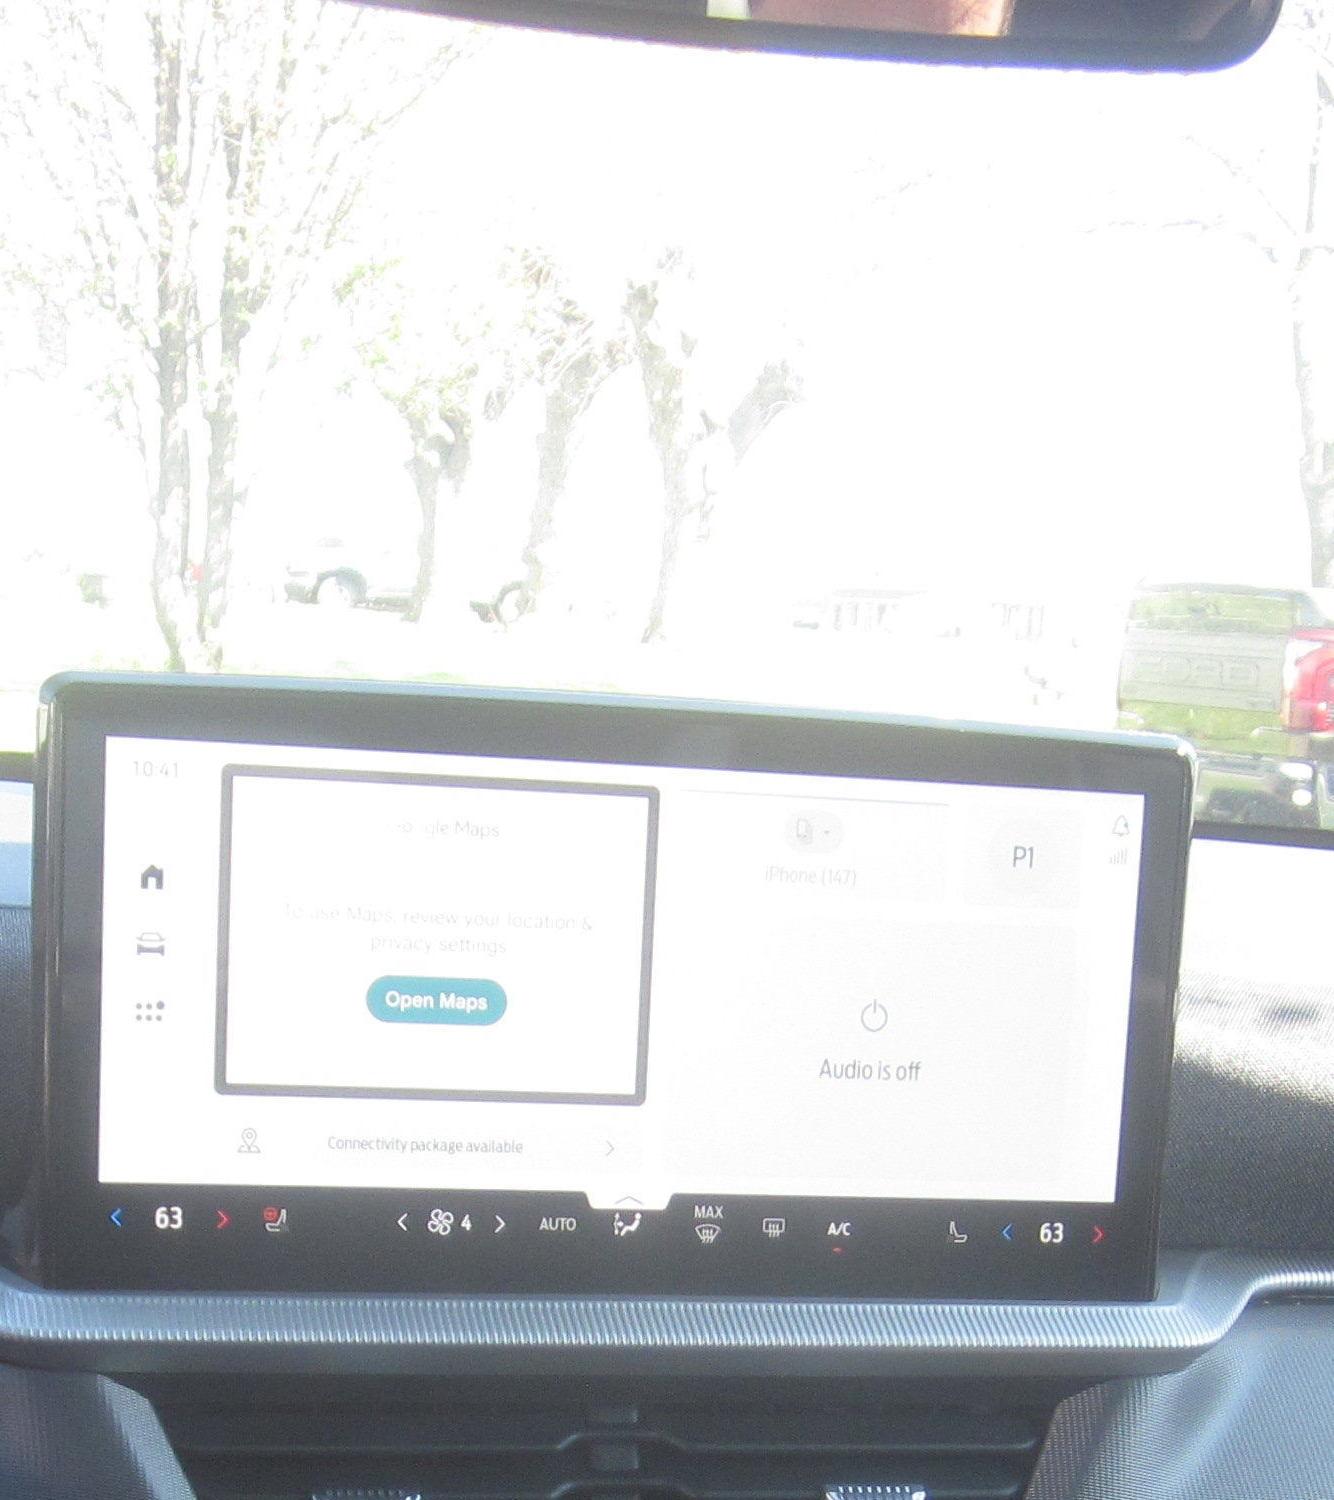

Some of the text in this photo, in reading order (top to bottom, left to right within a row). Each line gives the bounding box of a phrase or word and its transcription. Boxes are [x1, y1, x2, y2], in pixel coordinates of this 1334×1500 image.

[1012, 845, 1035, 869] P1
[765, 866, 817, 885] iPhone
[438, 934, 507, 957] settings
[385, 990, 488, 1013] Open Maps
[819, 1059, 922, 1082] Audio is off
[327, 1136, 524, 1155] Connectivity package available
[154, 1206, 577, 1232] 63 4 AUTO
[694, 1205, 724, 1219] MAX
[827, 1222, 1064, 1244] A/C 63
